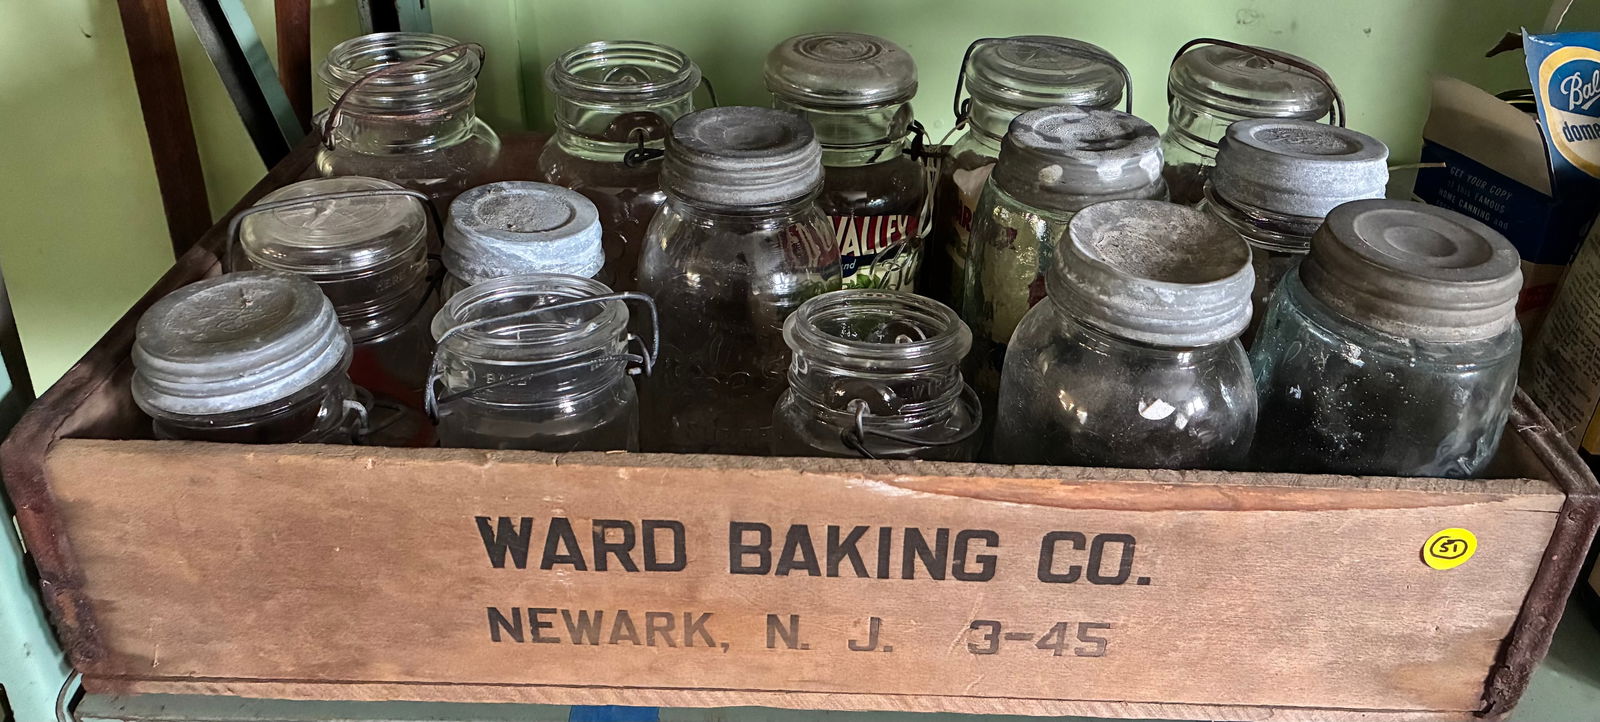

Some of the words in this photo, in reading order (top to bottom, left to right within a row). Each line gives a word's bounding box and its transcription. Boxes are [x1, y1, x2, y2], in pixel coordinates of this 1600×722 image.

[1562, 120, 1600, 143] dome
[1450, 166, 1464, 178] GET
[1467, 174, 1488, 189] YOUR
[1489, 184, 1513, 201] COPY
[1439, 187, 1457, 203] HOME
[1458, 198, 1491, 222] CANNING
[1474, 192, 1506, 214] FAMOUS
[827, 214, 909, 257] VALLEY
[475, 515, 688, 572] WARD
[729, 521, 999, 582] BAKING
[1038, 530, 1152, 585] CO.
[1439, 540, 1458, 553] 51
[486, 606, 729, 653] NEWARK,
[764, 613, 811, 650] N.
[847, 616, 894, 654] J.
[967, 619, 1111, 658] 3-45
